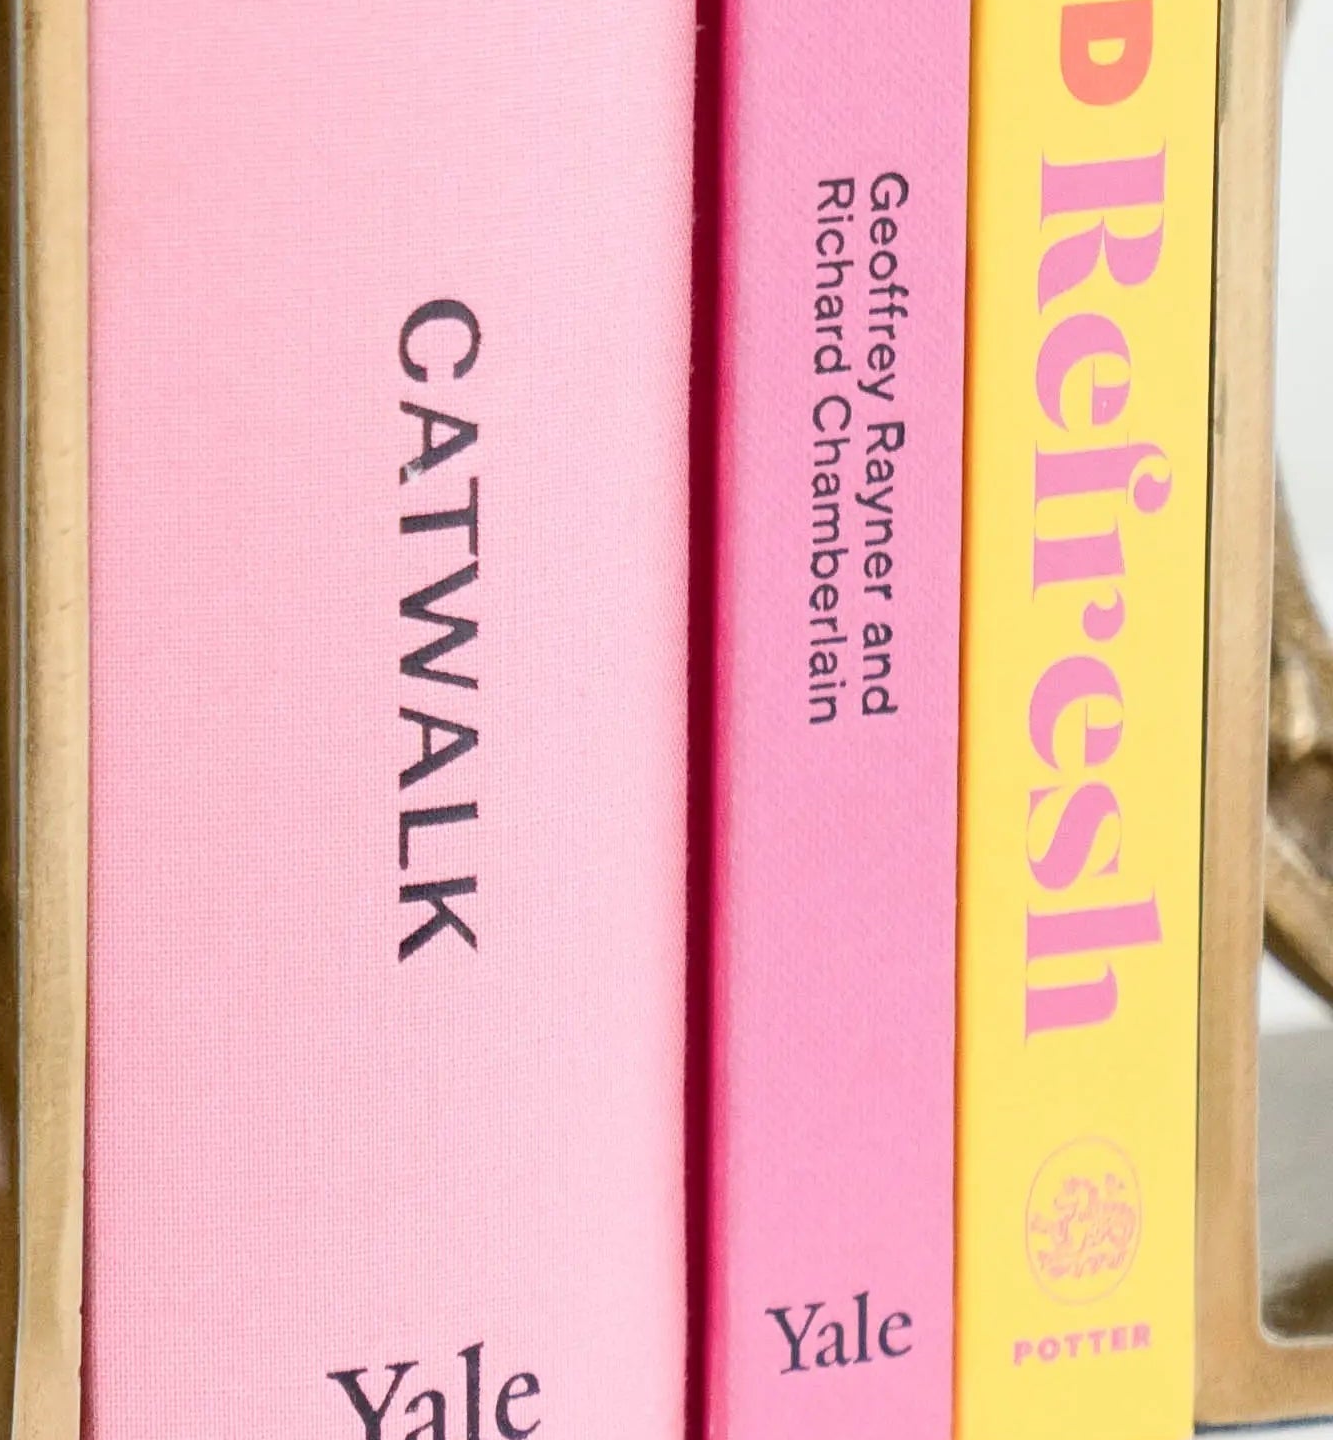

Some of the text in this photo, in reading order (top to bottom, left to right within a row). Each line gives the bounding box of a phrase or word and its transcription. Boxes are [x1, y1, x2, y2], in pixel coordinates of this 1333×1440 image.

[397, 298, 482, 962] CATWALK
[808, 176, 856, 725] Richard Chamberlain
[855, 171, 910, 717] Geoffrey Rayner and
[1024, 136, 1173, 1045] Refresh
[766, 1290, 914, 1374] Yale
[1012, 1322, 1151, 1368] POTTER
